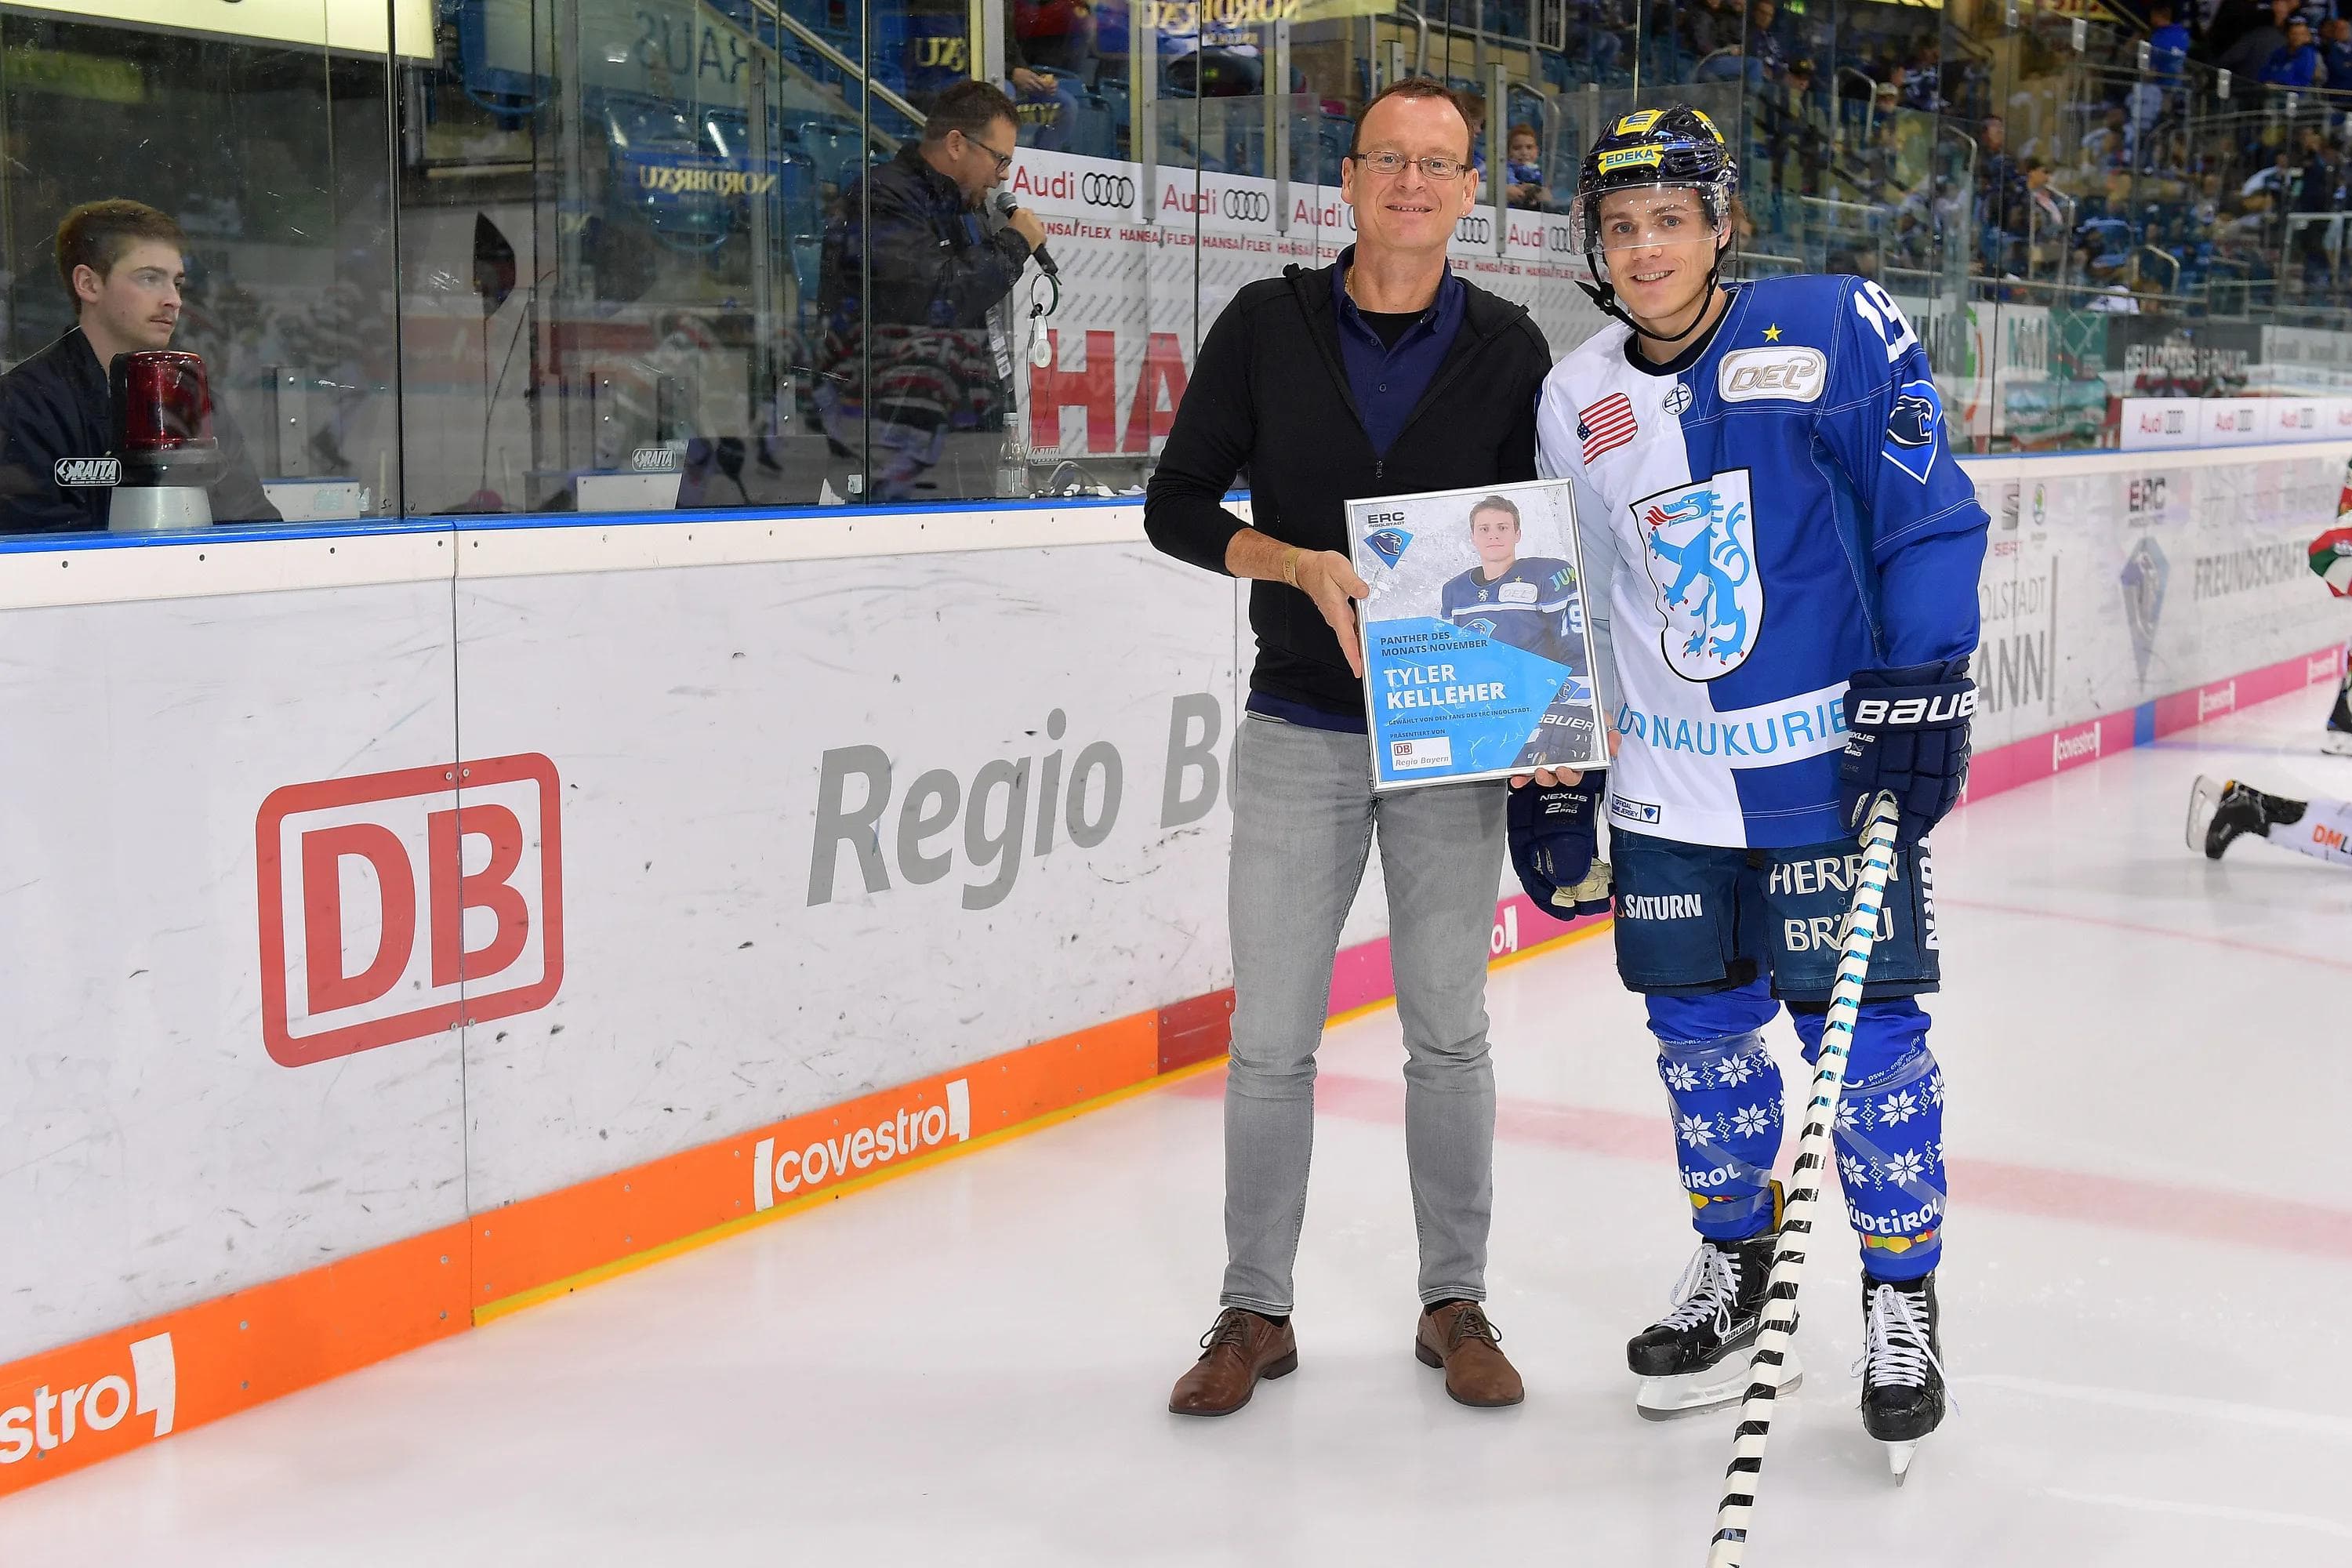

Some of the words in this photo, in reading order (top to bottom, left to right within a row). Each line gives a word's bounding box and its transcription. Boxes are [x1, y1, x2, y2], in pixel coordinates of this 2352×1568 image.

[1606, 148, 1654, 165] EDEKA
[1012, 165, 1075, 200] Audi
[1162, 183, 1217, 215] Audi
[1294, 199, 1341, 227] Audi
[1853, 280, 1918, 364] 19
[1367, 512, 1405, 524] ERC
[1381, 633, 1429, 645] PANTHER
[1432, 631, 1450, 641] DES
[1381, 644, 1428, 657] MONATS
[1430, 639, 1488, 652] NOVEMBER
[1383, 663, 1457, 688] TYLER
[1386, 681, 1507, 710] KELLEHER
[1396, 745, 1410, 755] DB
[1396, 757, 1418, 768] Regio
[1421, 756, 1450, 768] Bayern
[807, 708, 1123, 911] Regio
[1160, 691, 1237, 829] B
[1539, 793, 1588, 803] NEXUS
[301, 804, 530, 1016] DB
[1624, 893, 1703, 921] SATURN
[775, 1105, 946, 1194] covestro
